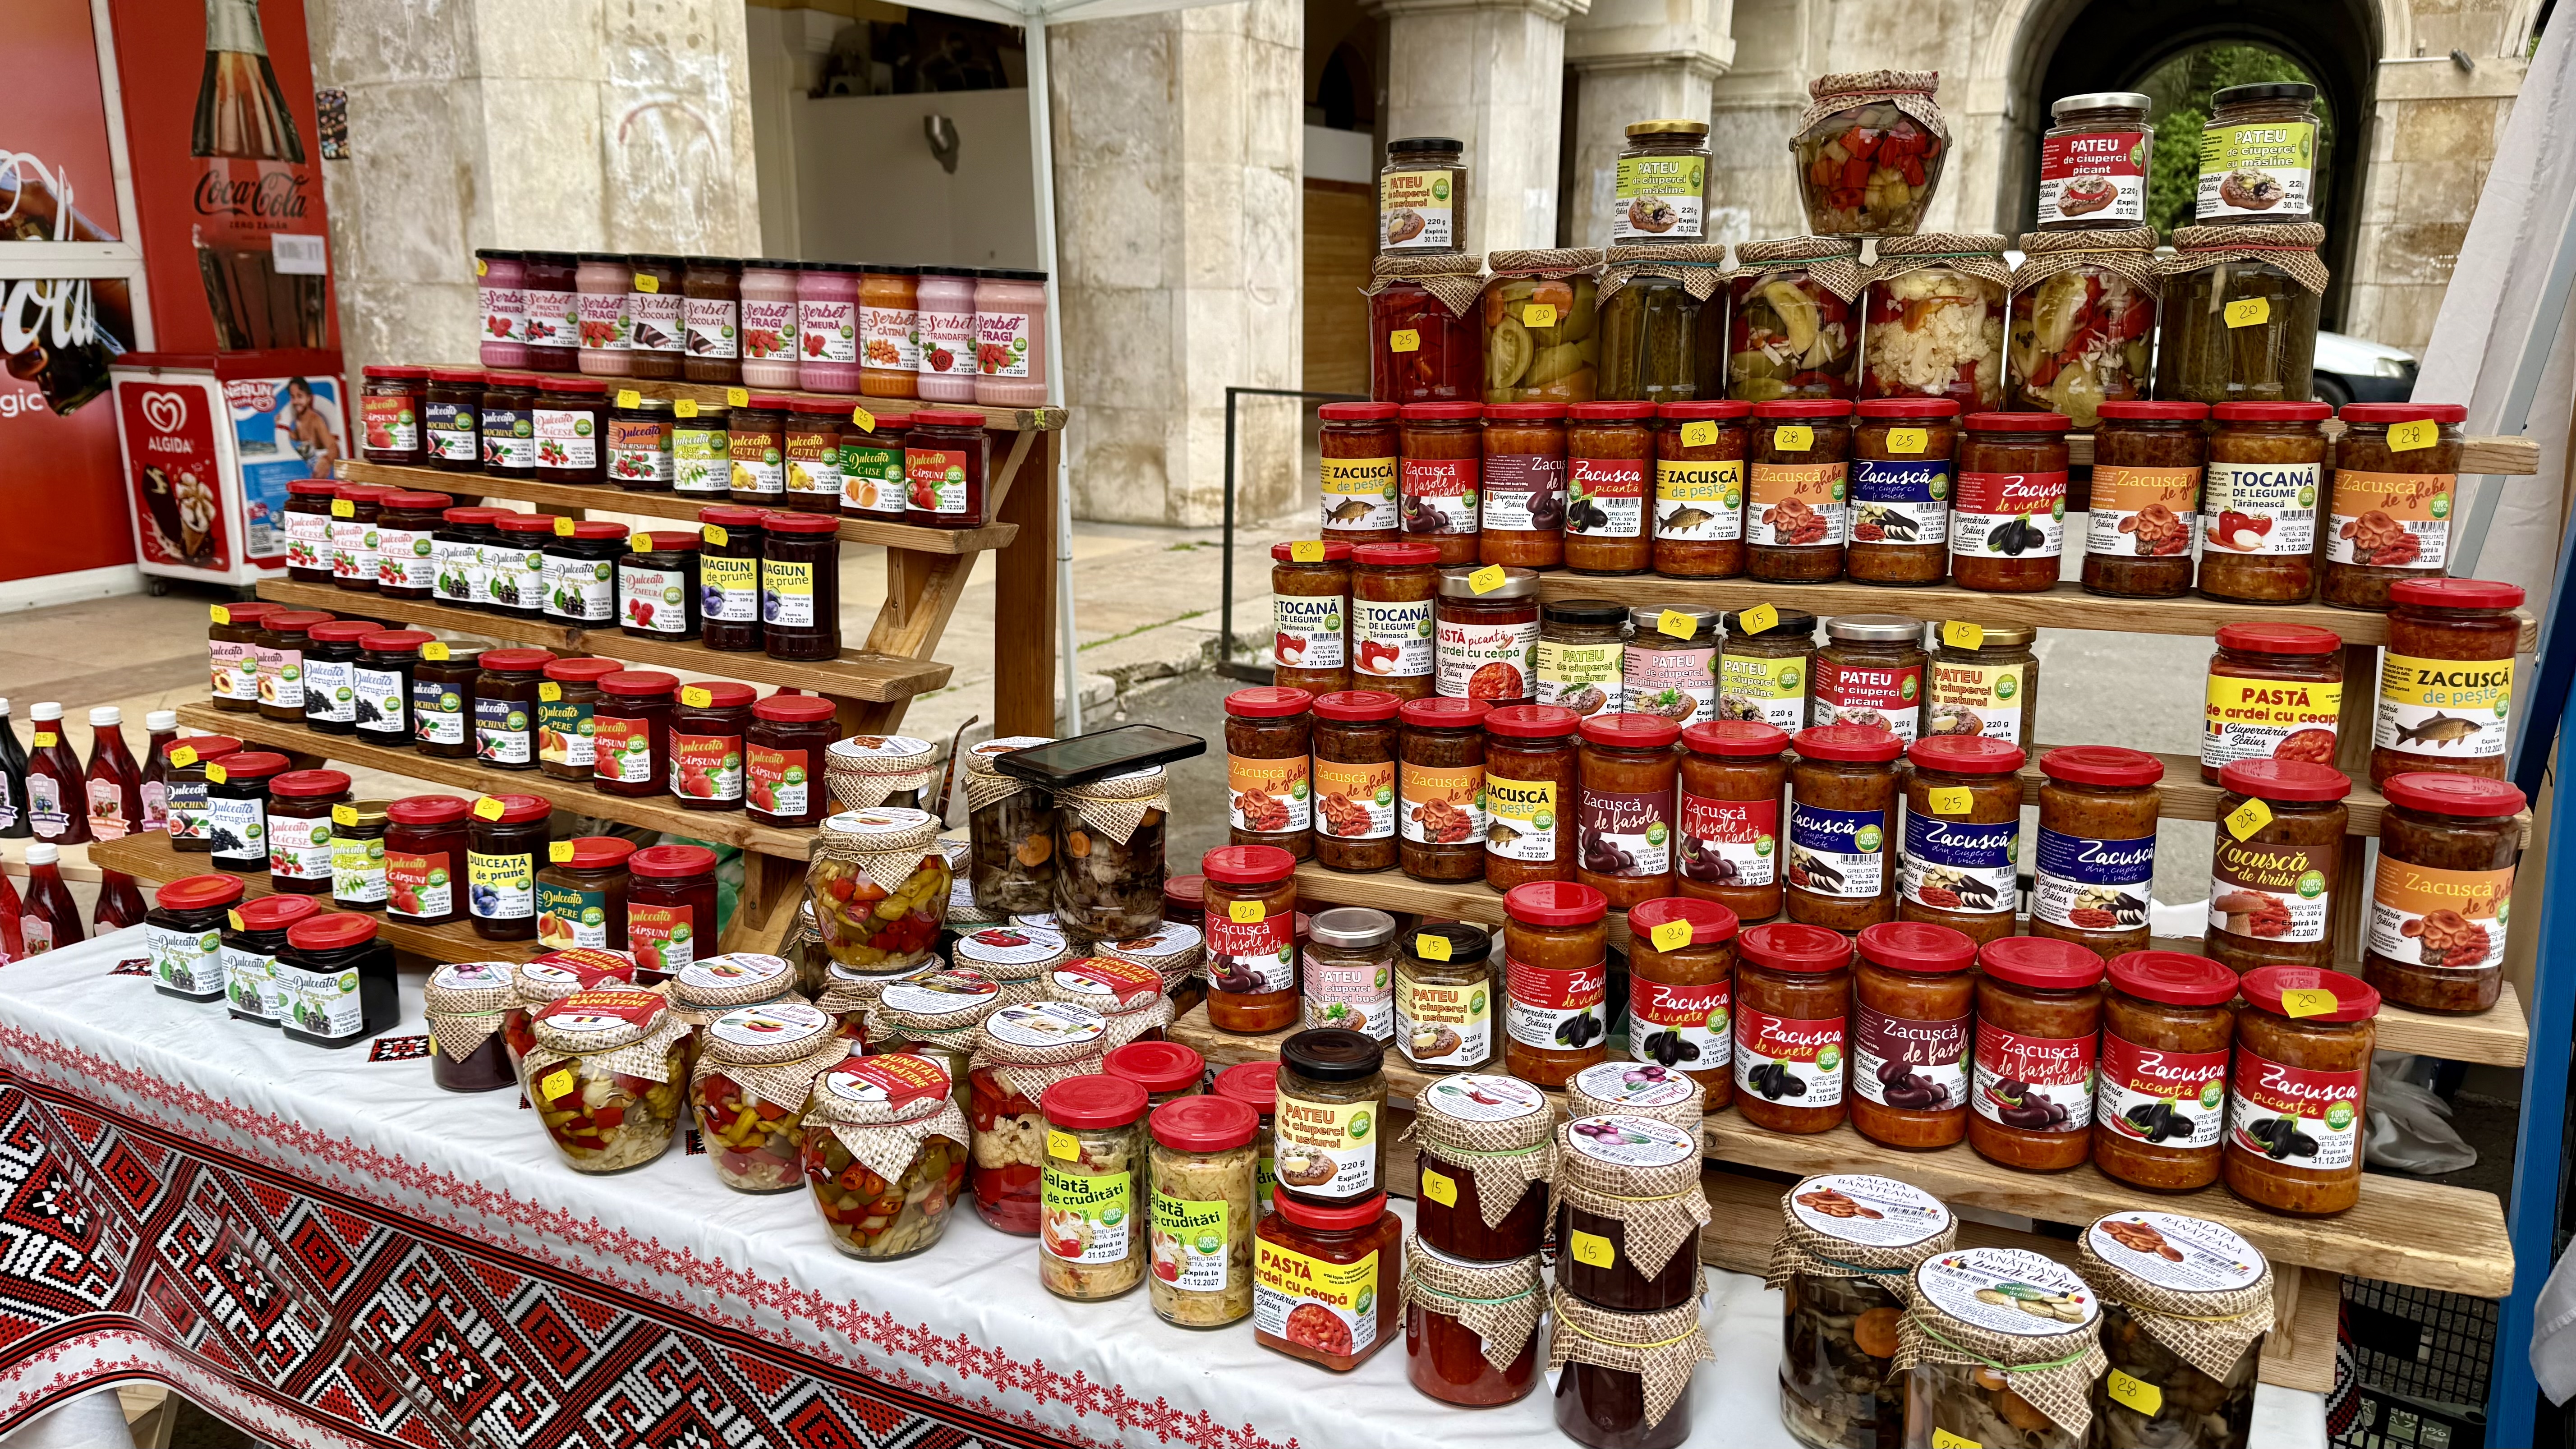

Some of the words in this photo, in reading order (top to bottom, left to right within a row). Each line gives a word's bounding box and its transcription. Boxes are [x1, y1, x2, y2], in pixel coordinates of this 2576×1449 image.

[2235, 129, 2286, 144] PATEU
[2071, 139, 2118, 153] PATEU
[2226, 147, 2238, 157] de
[2240, 143, 2296, 156] ciuperci
[2064, 155, 2074, 164] de
[2077, 153, 2126, 164] ciuperci
[2226, 160, 2238, 168] cu
[2241, 157, 2294, 167] măsline
[1638, 162, 1679, 174] PATEU
[2073, 165, 2111, 175] picant
[1642, 175, 1686, 185] ciuperci
[194, 170, 309, 217] Coca-Cola
[1642, 186, 1684, 194] măsline
[588, 310, 617, 319] FRAGI
[1536, 310, 1550, 321] 20
[2239, 304, 2258, 319] 20
[751, 318, 782, 328] FRAGI
[807, 319, 840, 330] ZMEURĂ
[878, 326, 906, 337] CĂTINĂ
[982, 331, 1012, 342] FRAGI
[1398, 334, 1412, 345] 25
[149, 436, 192, 454] ALGIDA
[1896, 435, 1914, 446] 25
[733, 447, 762, 456] GUTUI
[858, 467, 881, 476] CAISE
[912, 469, 944, 480] CĂPȘUNI
[1334, 463, 1394, 478] ZACUSCĂ
[1406, 461, 1456, 477] Zacuscă
[1576, 461, 1641, 482] Zacusca
[1668, 467, 1738, 484] ZACUSCĂ
[1761, 467, 1821, 482] Zacuscă
[1859, 462, 1931, 484] Zacuscă
[2231, 467, 2314, 487] TOCANĂ
[1337, 481, 1350, 492] de
[1354, 477, 1384, 493] pește
[1672, 486, 1685, 498] de
[1691, 483, 1726, 498] pește
[1794, 480, 1808, 496] de
[2002, 475, 2067, 497] Zacusca
[2342, 474, 2417, 494] Zacuscă
[2233, 488, 2246, 497] DE
[2249, 488, 2295, 498] LEGUME
[1996, 500, 2009, 511] de
[2233, 499, 2285, 508] Țărănească
[1300, 543, 1312, 554] 20
[702, 557, 750, 572] MAGIUN
[707, 572, 718, 581] de
[720, 571, 753, 584] prune
[766, 577, 777, 586] de
[779, 576, 809, 589] prune
[634, 587, 662, 598] ZMEURĂ
[1280, 599, 1338, 614] TOCANĂ
[1367, 604, 1430, 621] TOCANĂ
[1292, 615, 1322, 623] LEGUME
[1670, 619, 1682, 628] 15
[1370, 631, 1408, 639] Țărănească
[1437, 629, 1464, 644] PASTĂ
[1956, 626, 1970, 639] 15
[1563, 649, 1604, 662] PATEU
[1652, 655, 1695, 667] PATEU
[1574, 673, 1607, 682] mărar
[1637, 677, 1673, 689] ghimbir
[1840, 671, 1892, 686] PATEU
[2417, 667, 2509, 687] ZACUSCĂ
[1844, 697, 1884, 708] picant
[1945, 697, 1987, 707] usturoi
[2241, 687, 2310, 707] PASTĂ
[2423, 689, 2437, 704] de
[2453, 687, 2498, 707] pește
[2207, 703, 2221, 716] de
[2225, 708, 2270, 721] ardei
[2274, 712, 2294, 722] cu
[552, 722, 572, 731] PERE
[680, 756, 721, 766] CĂPȘUNI
[750, 766, 782, 781] CĂPȘUNI
[1233, 762, 1285, 779] Zacuscă
[1347, 783, 1359, 797] de
[1583, 790, 1641, 812] Zacuscă
[1944, 796, 1962, 810] 25
[1595, 811, 1609, 830] de
[1613, 804, 1660, 833] fasole
[1926, 820, 2009, 848] Zacuscă
[554, 845, 566, 856] 25
[470, 856, 528, 871] DULCEAȚĂ
[476, 870, 490, 880] de
[491, 868, 525, 881] prune
[2238, 867, 2255, 882] de
[2257, 867, 2295, 888] hribi
[2301, 878, 2321, 888] 100%
[557, 908, 578, 918] PERE
[1239, 906, 1255, 918] 20
[1426, 940, 1440, 953] 15
[1319, 970, 1362, 983] PATEU
[567, 998, 650, 1007] BĂNĂȚENE
[570, 992, 658, 1000] BUNĂTĂȚI
[1412, 989, 1458, 1003] PATEU
[1651, 985, 1729, 1008] Zacusca
[1884, 1019, 1958, 1040] Zacuscă
[1754, 1039, 1767, 1053] de
[2001, 1035, 2079, 1059] Zacuscă
[869, 1059, 929, 1088] BĂNĂȚENE
[880, 1053, 944, 1083] BUNĂTĂȚI
[549, 1076, 565, 1090] 25
[2259, 1063, 2358, 1100] Zacusca
[1053, 1135, 1068, 1148] 20
[1341, 1159, 1357, 1170] 220
[1359, 1160, 1366, 1170] g
[2312, 1155, 2351, 1164] 31.12.2026
[1044, 1167, 1089, 1193] Salată
[1431, 1178, 1442, 1194] 15
[1857, 1176, 1906, 1190] SALATĂ
[1048, 1192, 1059, 1204] de
[1088, 1248, 1122, 1258] 31.12.2027
[1583, 1241, 1597, 1259] 15
[2117, 1378, 2137, 1397] 28
